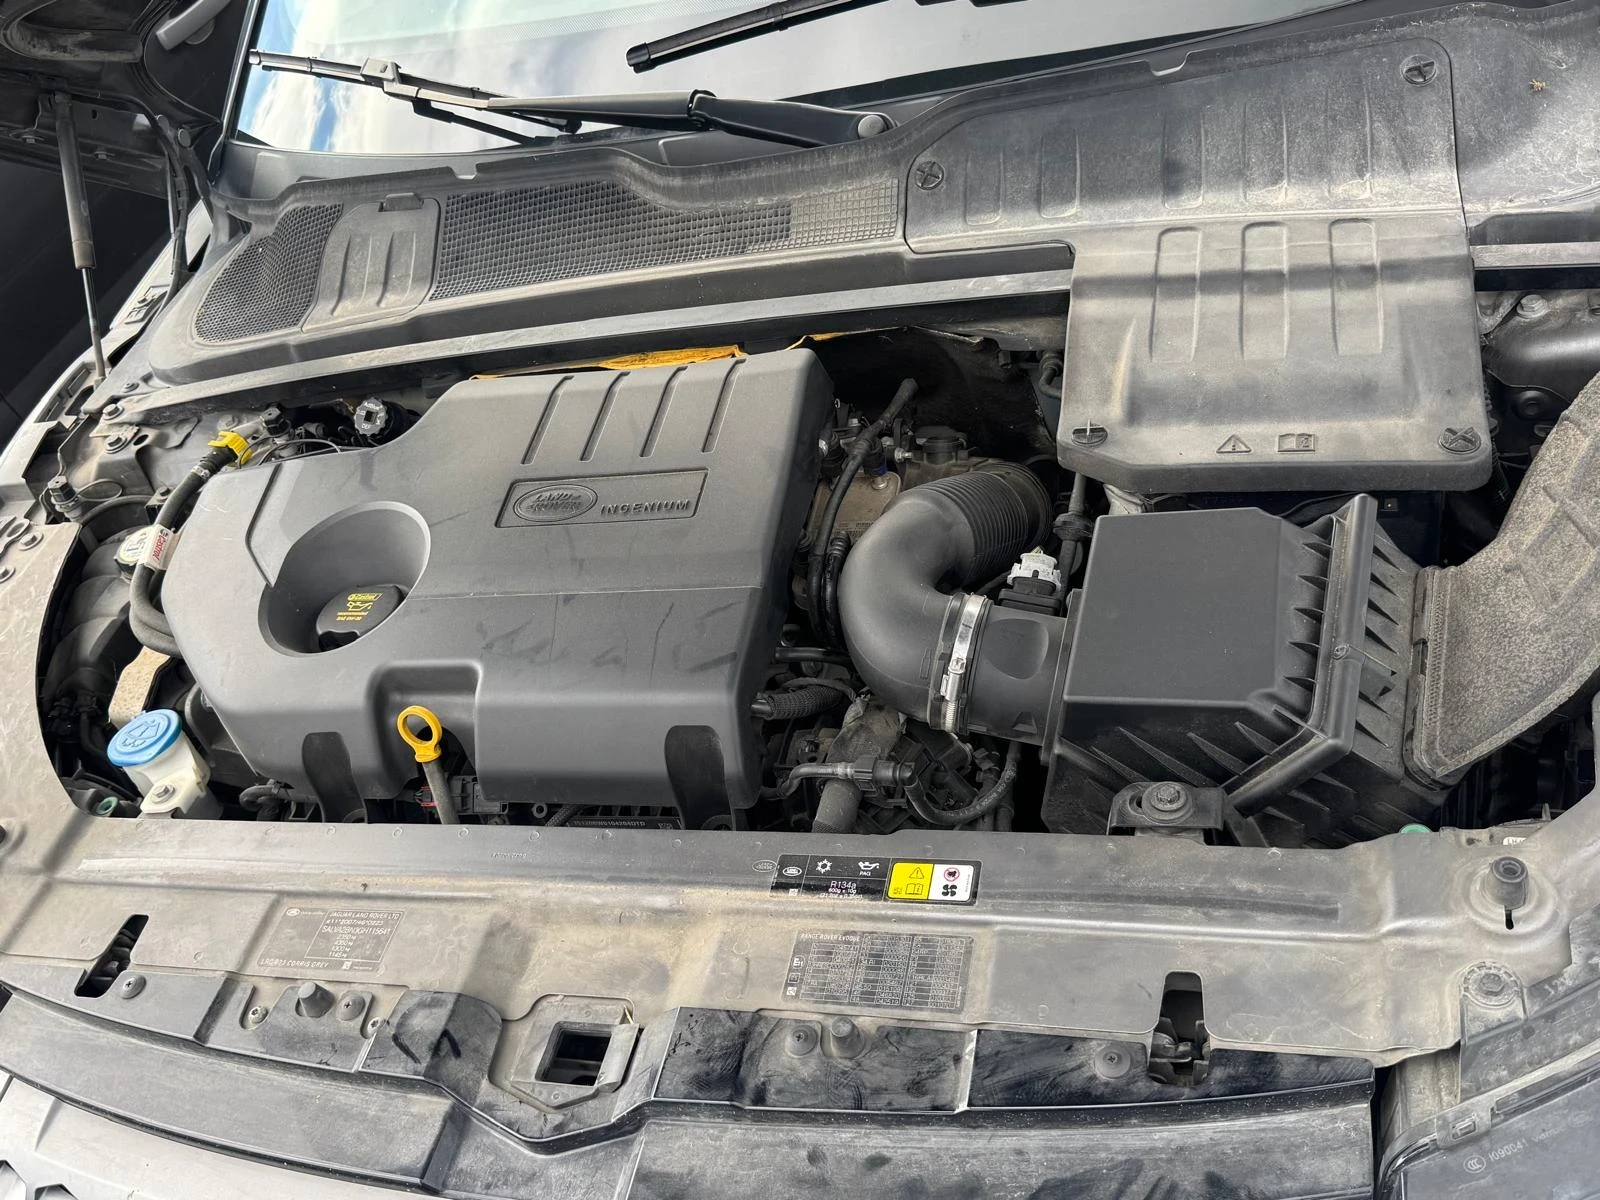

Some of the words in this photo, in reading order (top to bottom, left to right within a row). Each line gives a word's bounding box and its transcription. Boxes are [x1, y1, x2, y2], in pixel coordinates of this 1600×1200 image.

[600, 499, 690, 516] INGENIUM
[152, 534, 168, 561] Castrol
[830, 880, 856, 889] R134a
